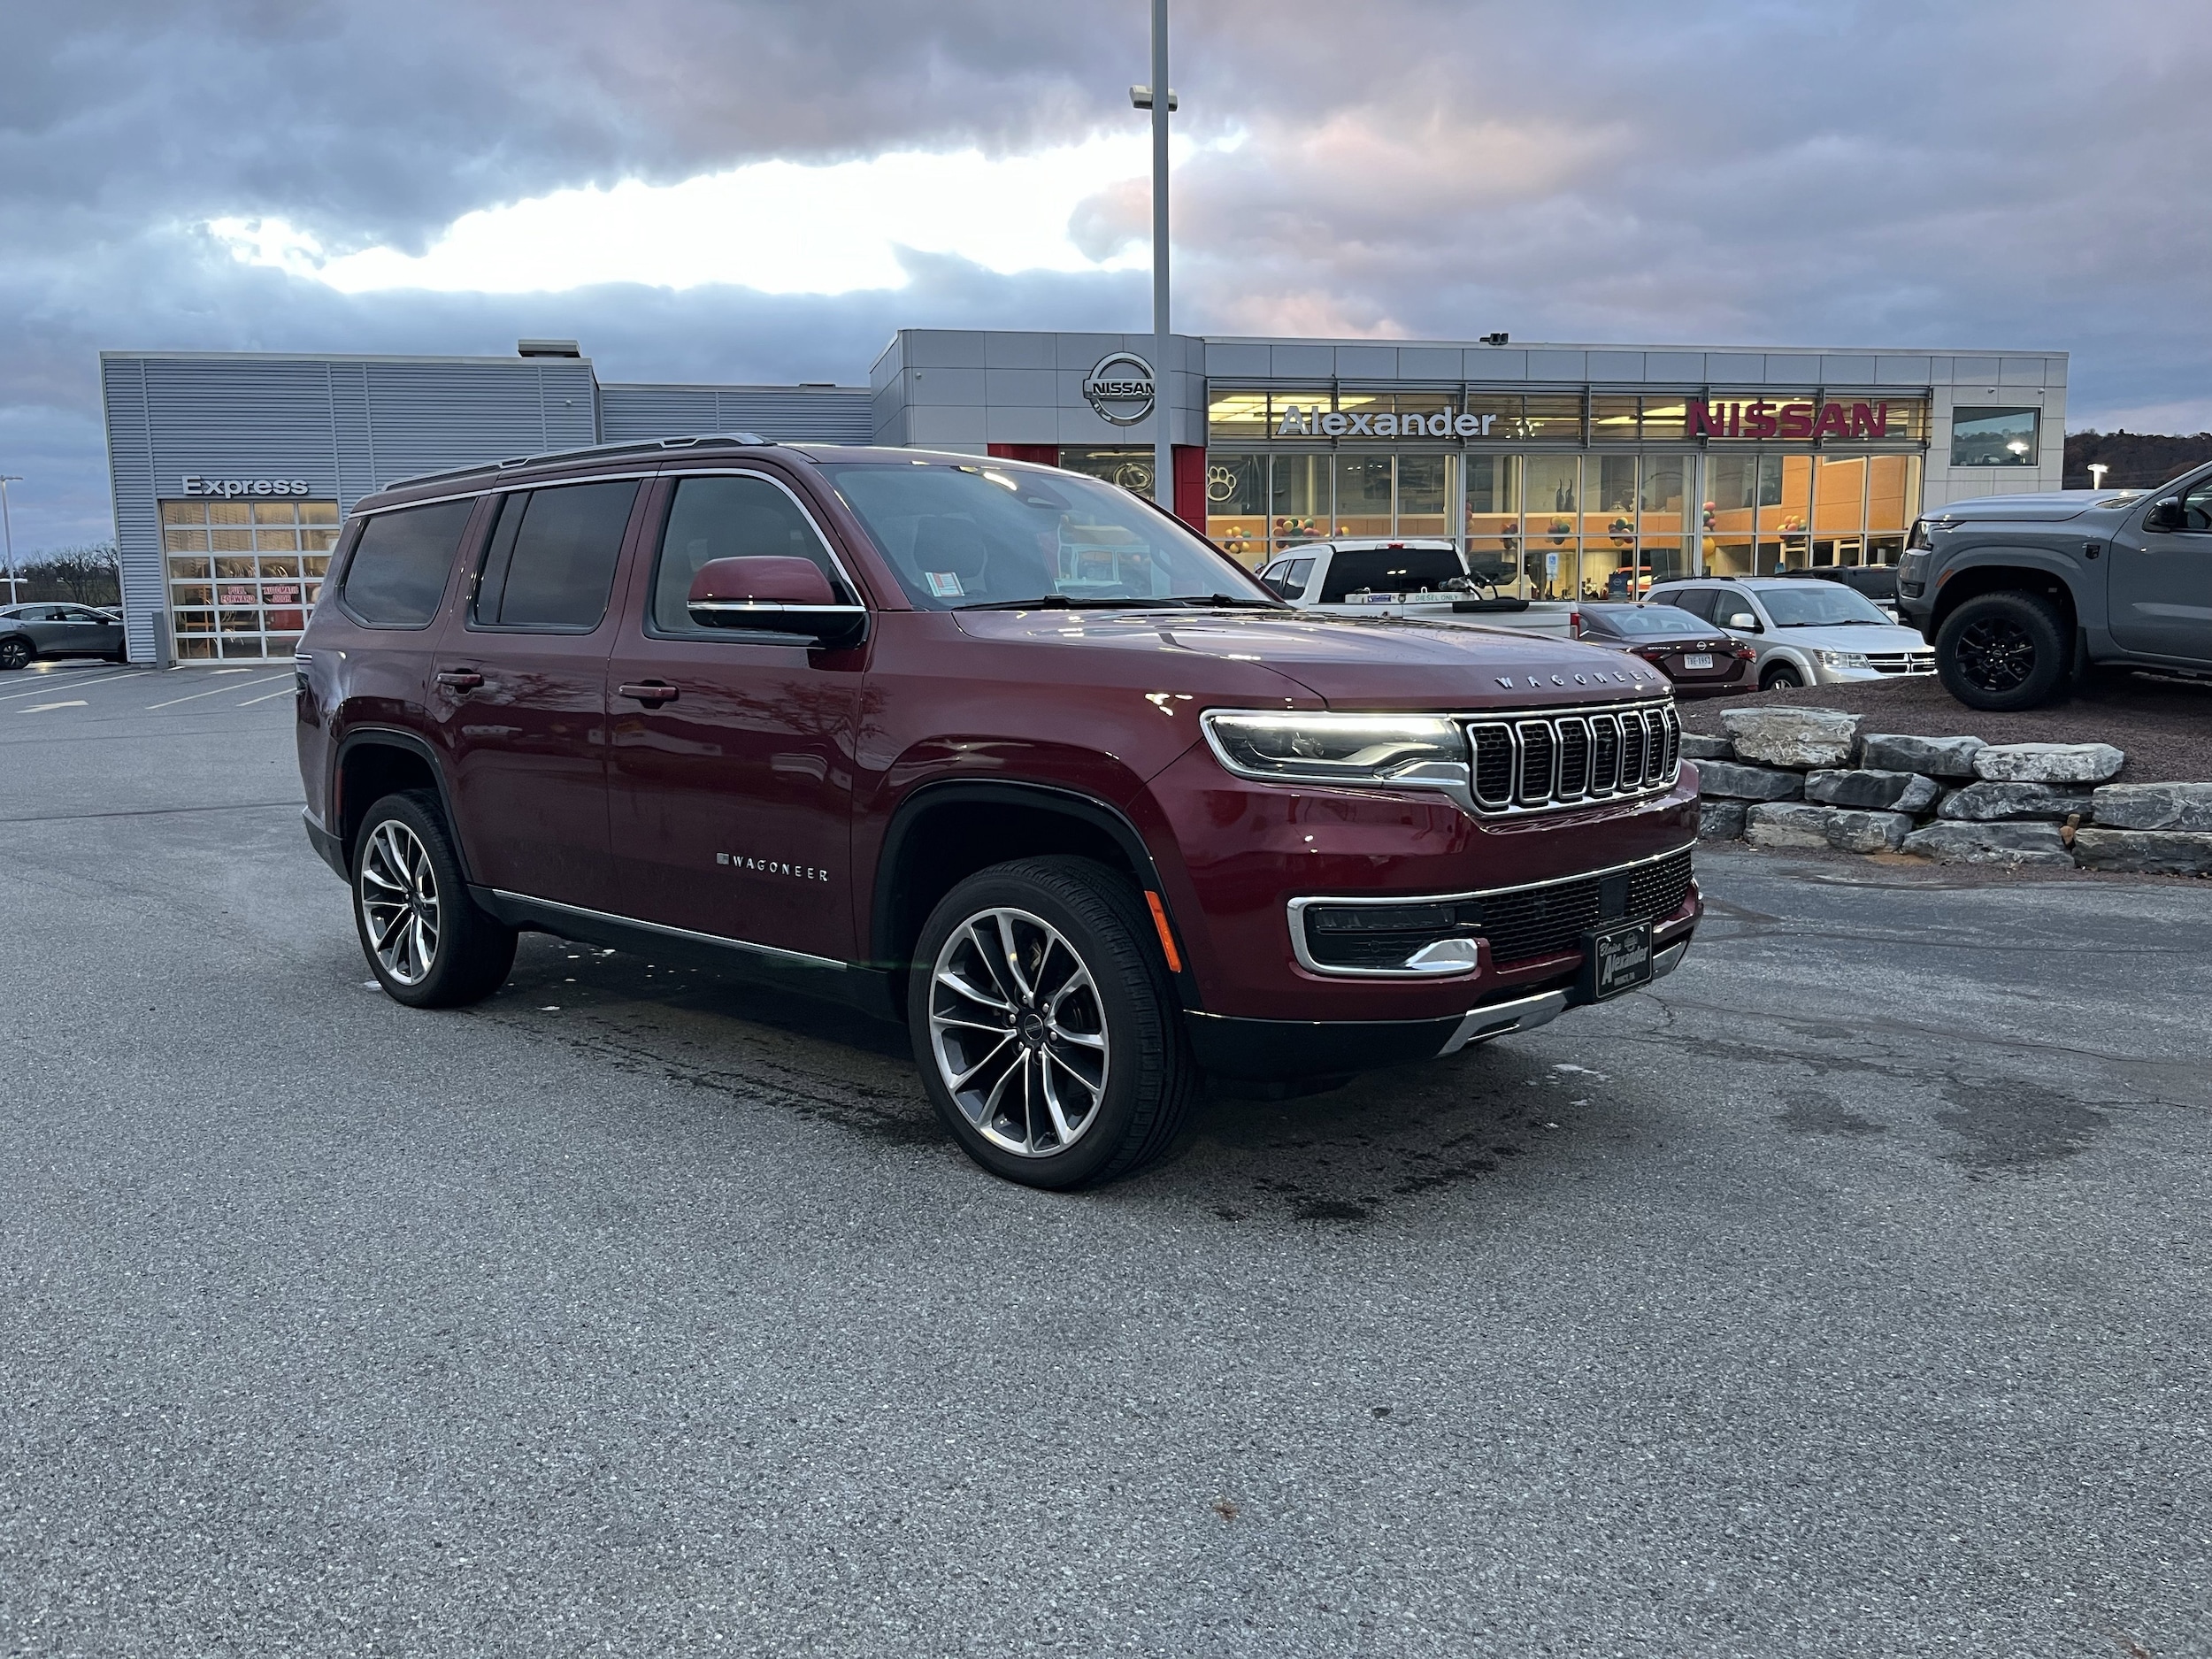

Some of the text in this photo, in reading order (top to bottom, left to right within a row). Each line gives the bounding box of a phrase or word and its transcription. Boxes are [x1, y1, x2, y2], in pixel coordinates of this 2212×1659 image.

[1093, 382, 1155, 396] NISSAN
[1277, 406, 1496, 436] Alexander
[1688, 402, 1886, 437] NISSAN
[181, 475, 309, 498] Express
[1494, 670, 1655, 689] WAGONEER
[733, 856, 828, 882] WAGONEER
[1601, 946, 1649, 987] Alexander
